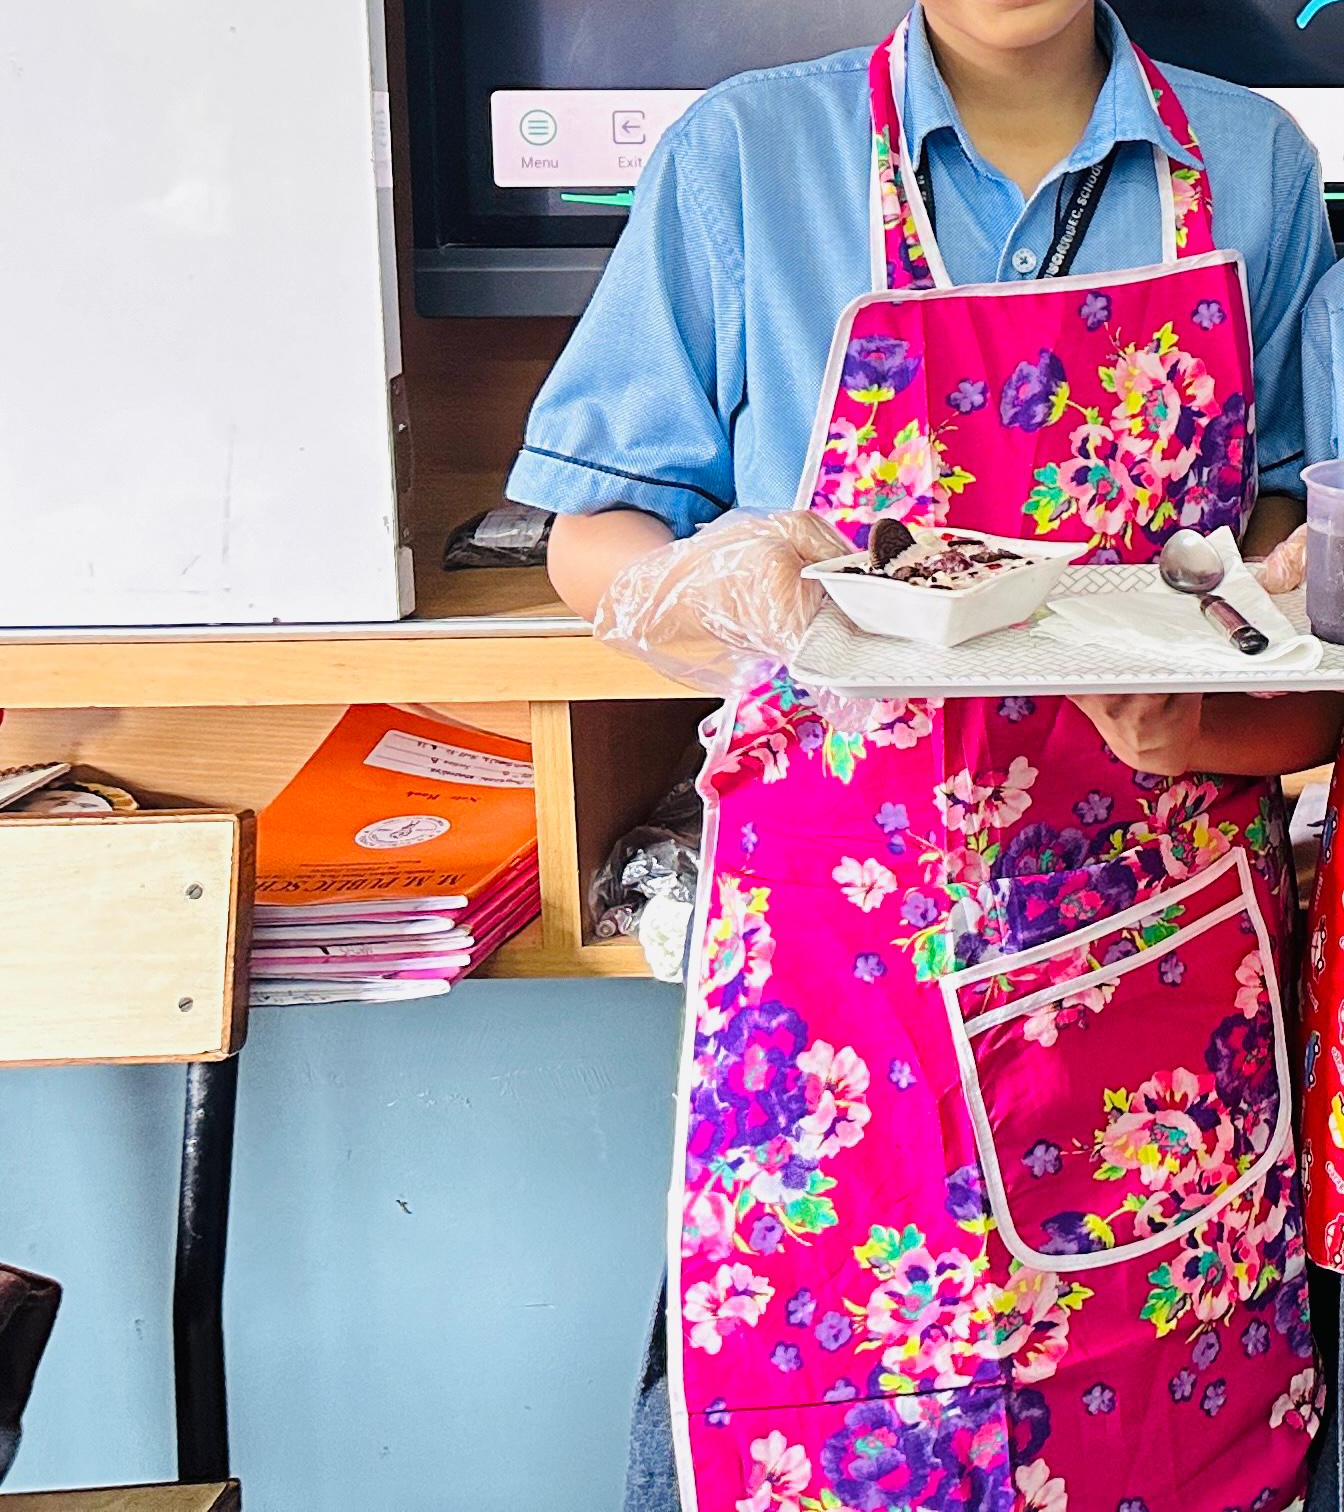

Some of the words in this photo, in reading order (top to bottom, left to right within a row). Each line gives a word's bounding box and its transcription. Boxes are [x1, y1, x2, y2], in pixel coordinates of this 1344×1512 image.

[520, 156, 559, 169] Menu
[617, 156, 643, 169] Exit
[256, 879, 303, 892] SCH
[304, 876, 401, 892] PUBLIC
